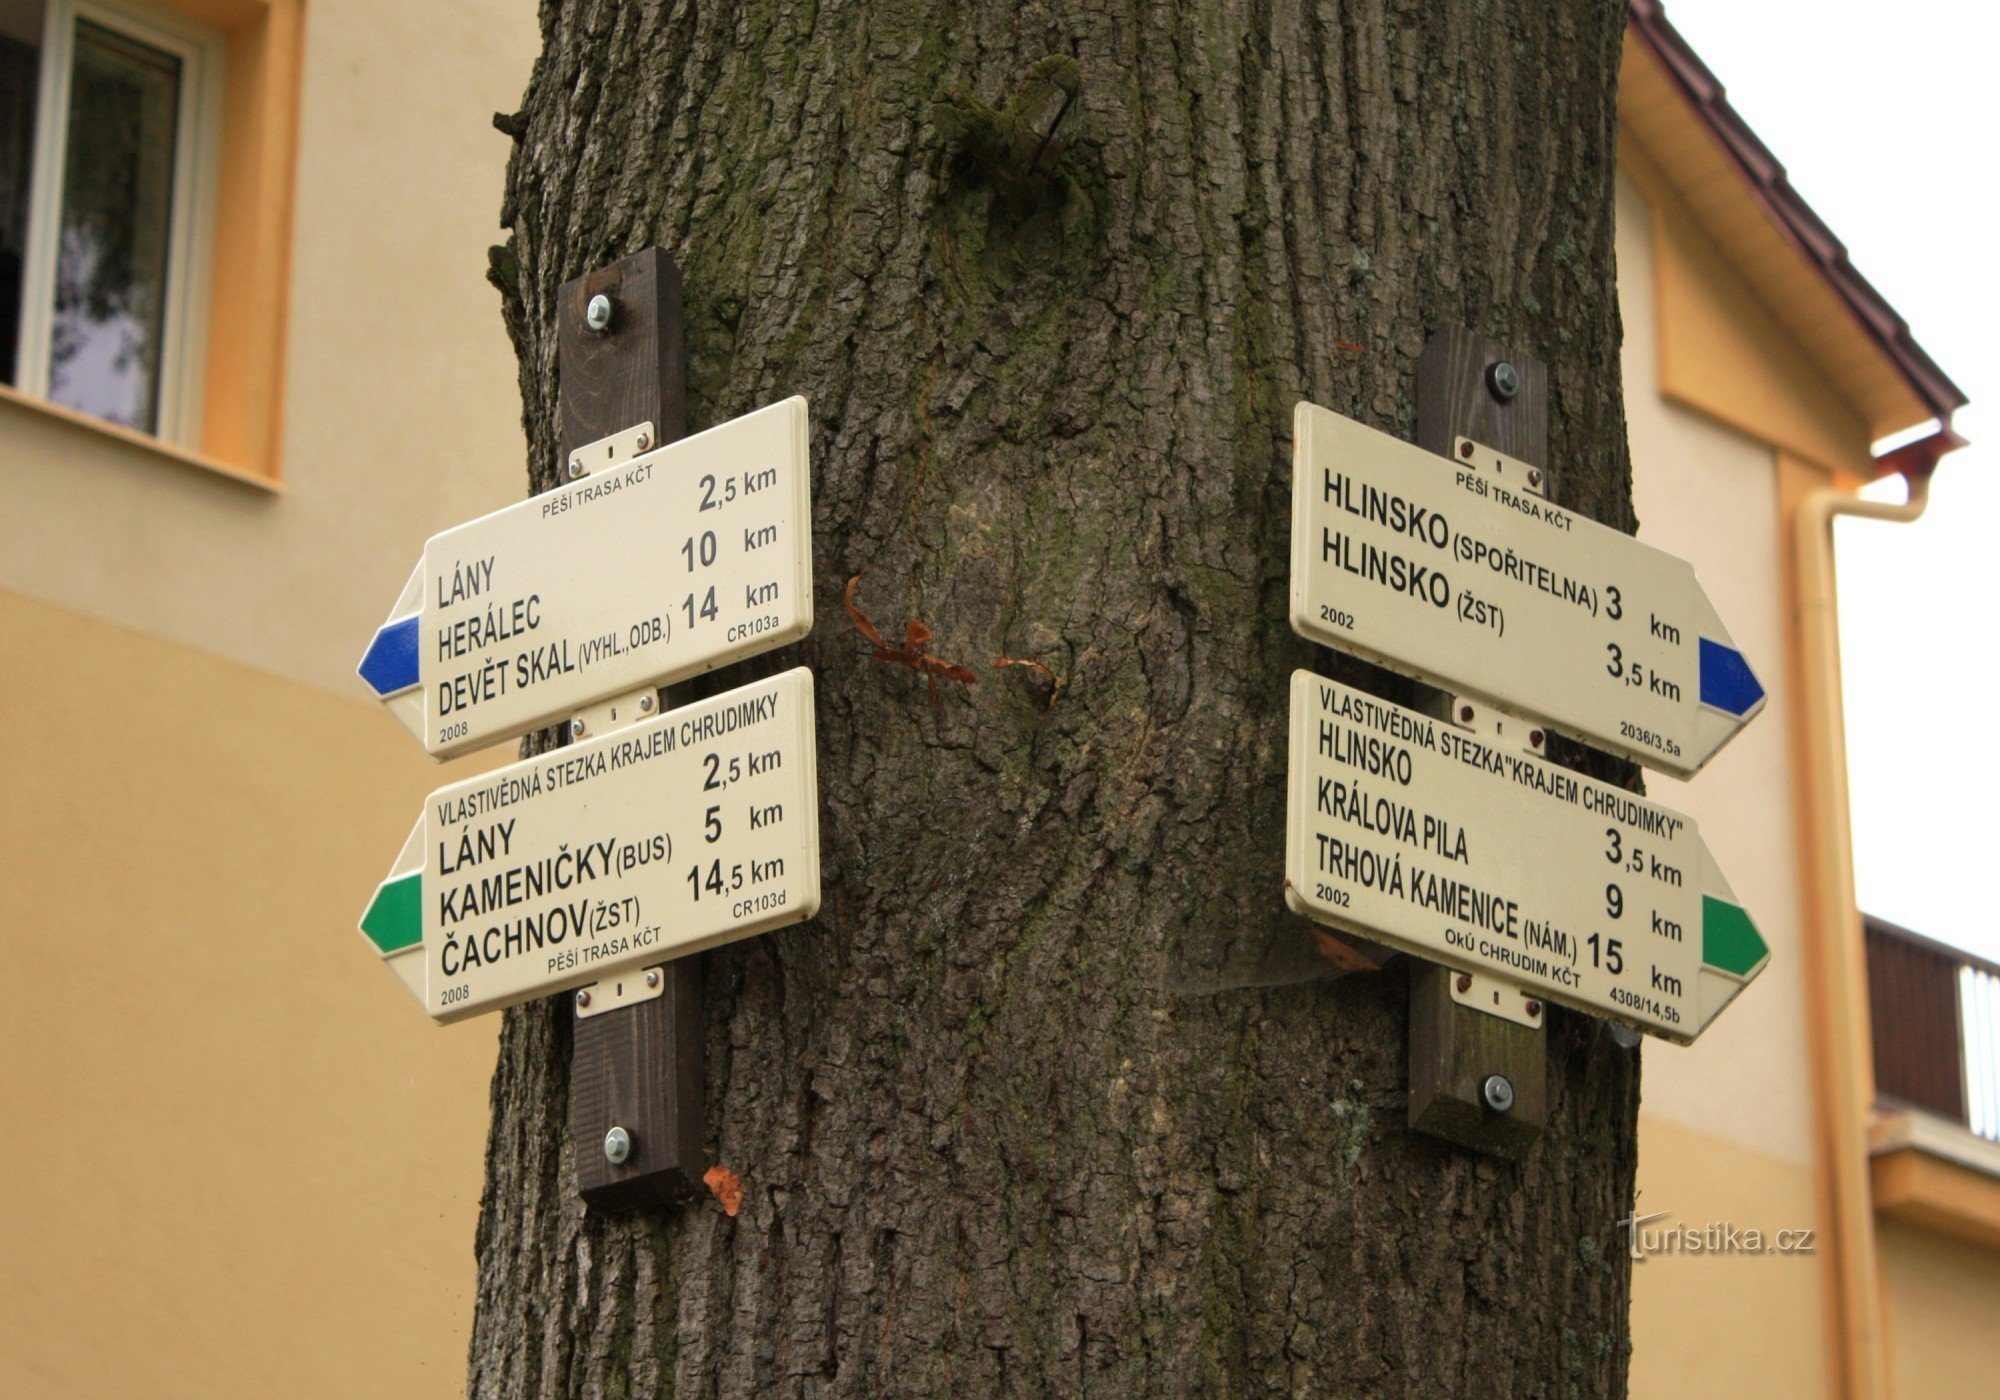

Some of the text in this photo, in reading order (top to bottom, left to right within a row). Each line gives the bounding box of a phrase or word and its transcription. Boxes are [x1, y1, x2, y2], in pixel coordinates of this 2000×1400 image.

[542, 464, 653, 519] PĚŠÍ TRASA KČT
[1456, 471, 1572, 532] PĚŠÍ TRASA KČT
[438, 468, 776, 610] LÁNY 2,5 km
[1324, 467, 1680, 646] HLINSKO (SPOŘITELNA) 3 km
[439, 525, 777, 665] HERÁLEC 10 km
[1320, 604, 1354, 631] 2002
[1323, 526, 1680, 703] HLINSKO (ŽST) 3,5 km
[439, 656, 509, 717] DEVĚT
[516, 639, 575, 689] SKAL
[682, 585, 719, 629] 14
[746, 581, 778, 609] km
[727, 615, 779, 643] CR103a
[438, 691, 778, 827] VLASTIVĚDNÁ STEZKA KRAJEM CHRUDIMKY
[440, 721, 468, 743] 2008
[1320, 684, 1437, 750] VLASTIVĚDNÁ
[1583, 785, 1683, 841] CHRUDIMKY"
[1620, 721, 1681, 757] 2036/3,5a
[439, 750, 781, 877] LÁNY 2,5 km
[704, 804, 722, 844] 5
[750, 803, 783, 831] km
[1319, 715, 1682, 888] HLINSKO 3,5 km
[687, 858, 743, 902] 14,5
[751, 858, 784, 885] km
[1318, 775, 1682, 943] KRÁLOVA PILA 9 km
[733, 889, 786, 919] CR103d
[1316, 883, 1350, 908] 2002
[1316, 832, 1682, 998] TRHOVÁ KAMENICE (NÁM.) 15 km
[548, 926, 661, 974] PĚŠÍ TRASA KČT
[1445, 928, 1581, 989] OkÚ CHRUDIM KČT
[441, 984, 469, 1006] 2008
[1609, 987, 1680, 1024] 4308/14,5b
